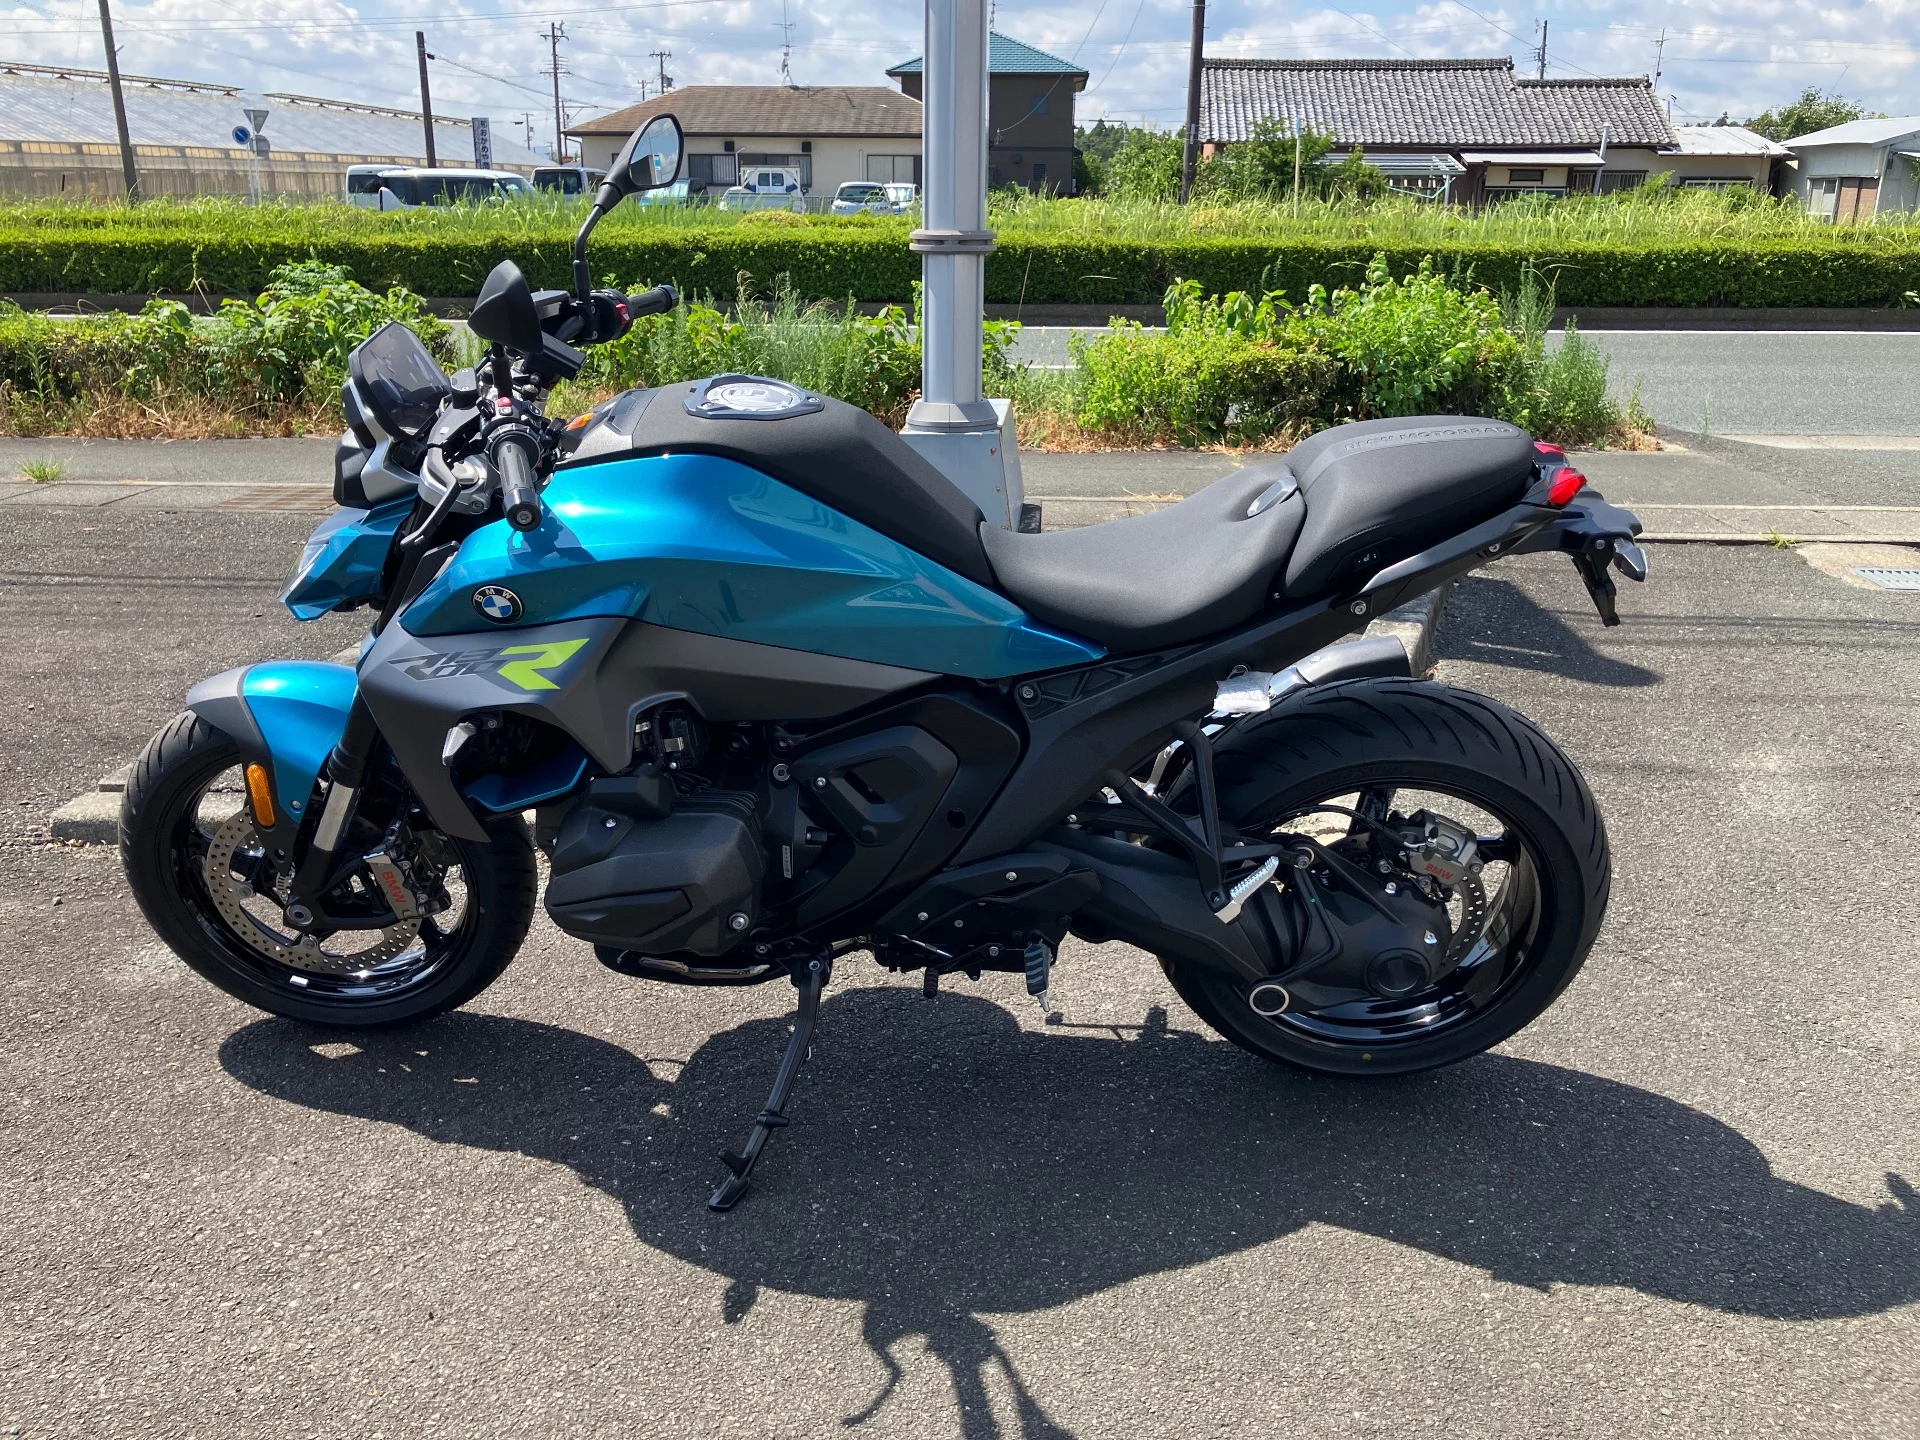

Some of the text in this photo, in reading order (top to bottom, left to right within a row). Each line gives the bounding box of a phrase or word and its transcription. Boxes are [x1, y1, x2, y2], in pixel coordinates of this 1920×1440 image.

[474, 588, 513, 603] BMW
[1425, 863, 1454, 880] BMW
[382, 870, 407, 903] BMW
